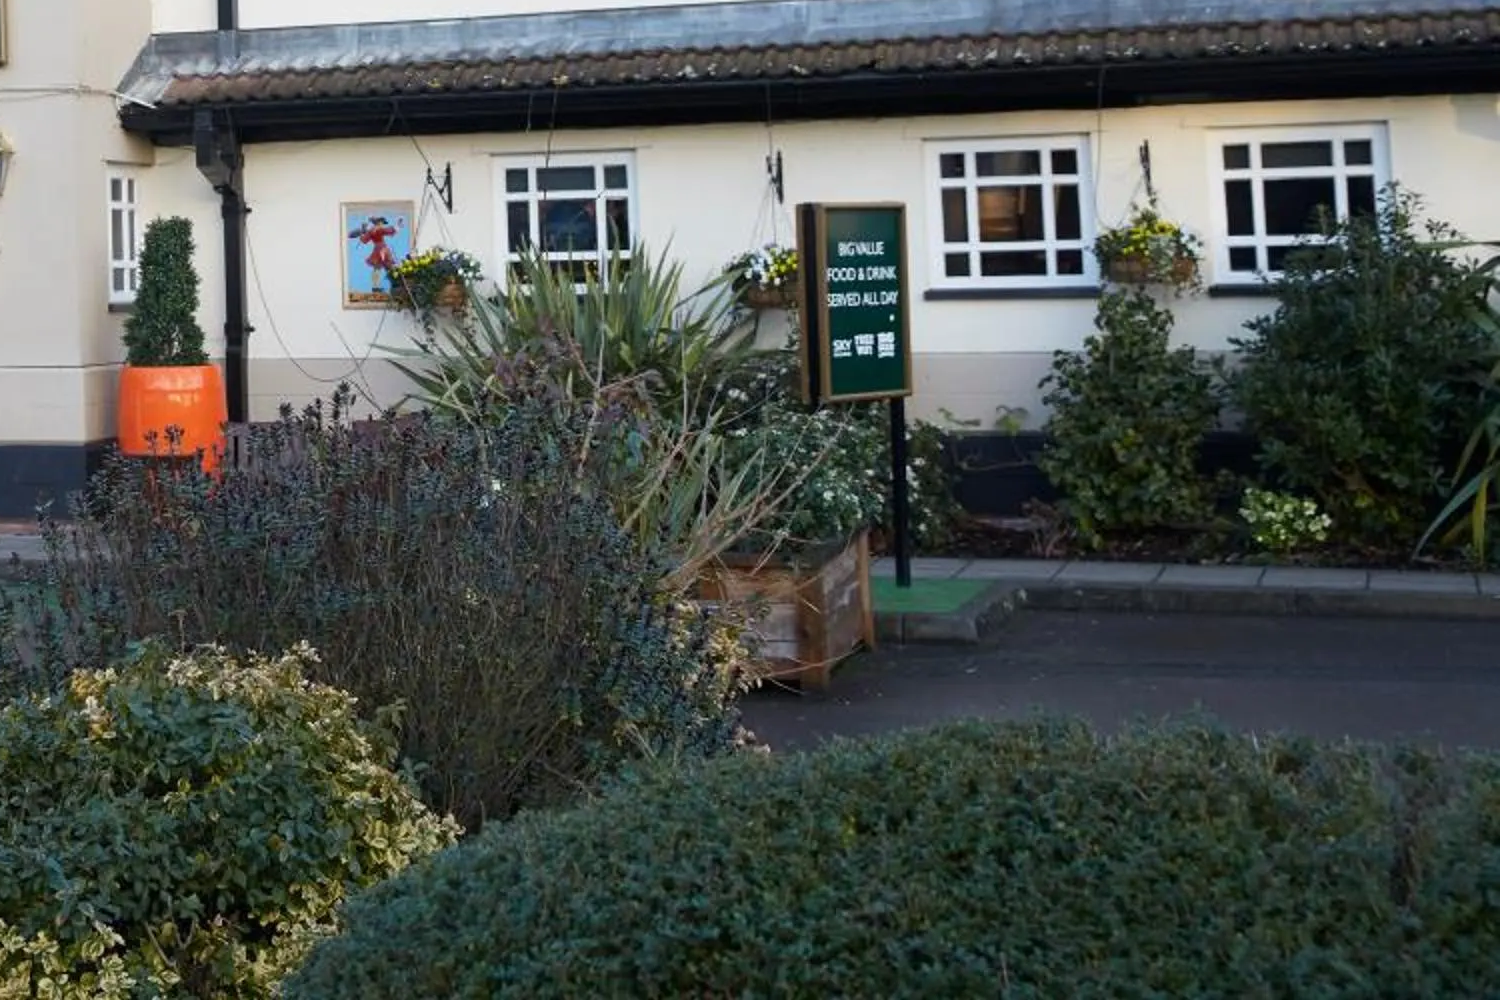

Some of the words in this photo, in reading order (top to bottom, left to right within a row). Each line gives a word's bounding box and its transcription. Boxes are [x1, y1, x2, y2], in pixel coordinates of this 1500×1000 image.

[837, 242, 856, 257] BIG
[856, 241, 885, 256] VALUE
[826, 267, 857, 282] FOOD
[857, 267, 865, 281] &
[866, 265, 897, 281] DRINK
[827, 292, 861, 307] SERVED
[862, 291, 881, 306] ALL
[880, 290, 899, 305] DAY
